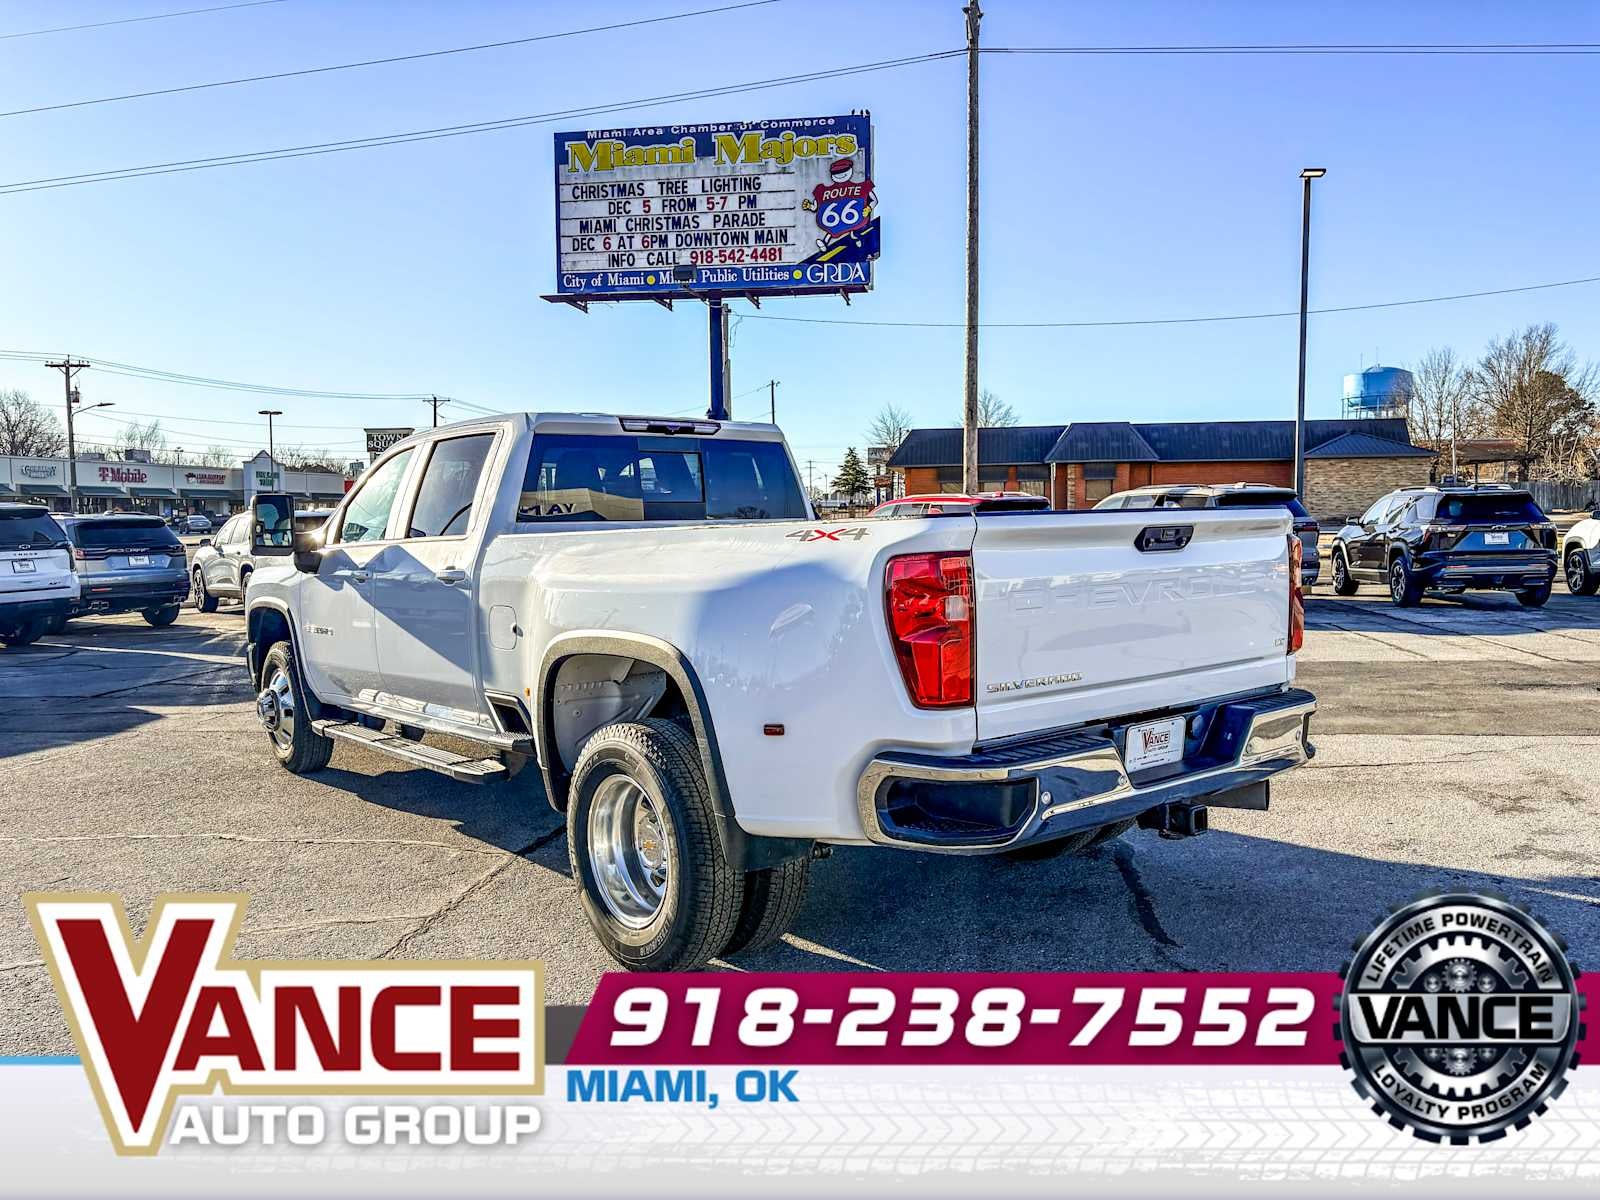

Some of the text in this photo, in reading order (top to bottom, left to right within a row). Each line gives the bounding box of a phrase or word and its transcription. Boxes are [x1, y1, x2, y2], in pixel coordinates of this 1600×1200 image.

[587, 129, 627, 139] Miami
[633, 128, 664, 137] Area
[671, 124, 733, 135] Chamber
[760, 117, 836, 129] Commerce
[566, 131, 858, 174] Miami Majors
[572, 176, 762, 200] CHRISTMAS TREE LIGHTING
[822, 186, 862, 201] ROUTE
[608, 195, 757, 215] DEC 5 FROM 5-7 PM
[821, 199, 859, 227] 66
[579, 212, 766, 234] MIAMI CHRISTMAS PARADE
[572, 229, 788, 251] DEC 6 AT 6PM DOWNTOWN MAIN
[608, 247, 783, 268] INFO CALL 918-542-4481
[563, 274, 586, 291] City
[591, 273, 603, 286] of
[608, 272, 645, 286] Miami
[702, 268, 738, 283] Public
[742, 267, 790, 282] Utilities
[806, 262, 866, 283] GRDA
[1143, 730, 1169, 753] VANCE
